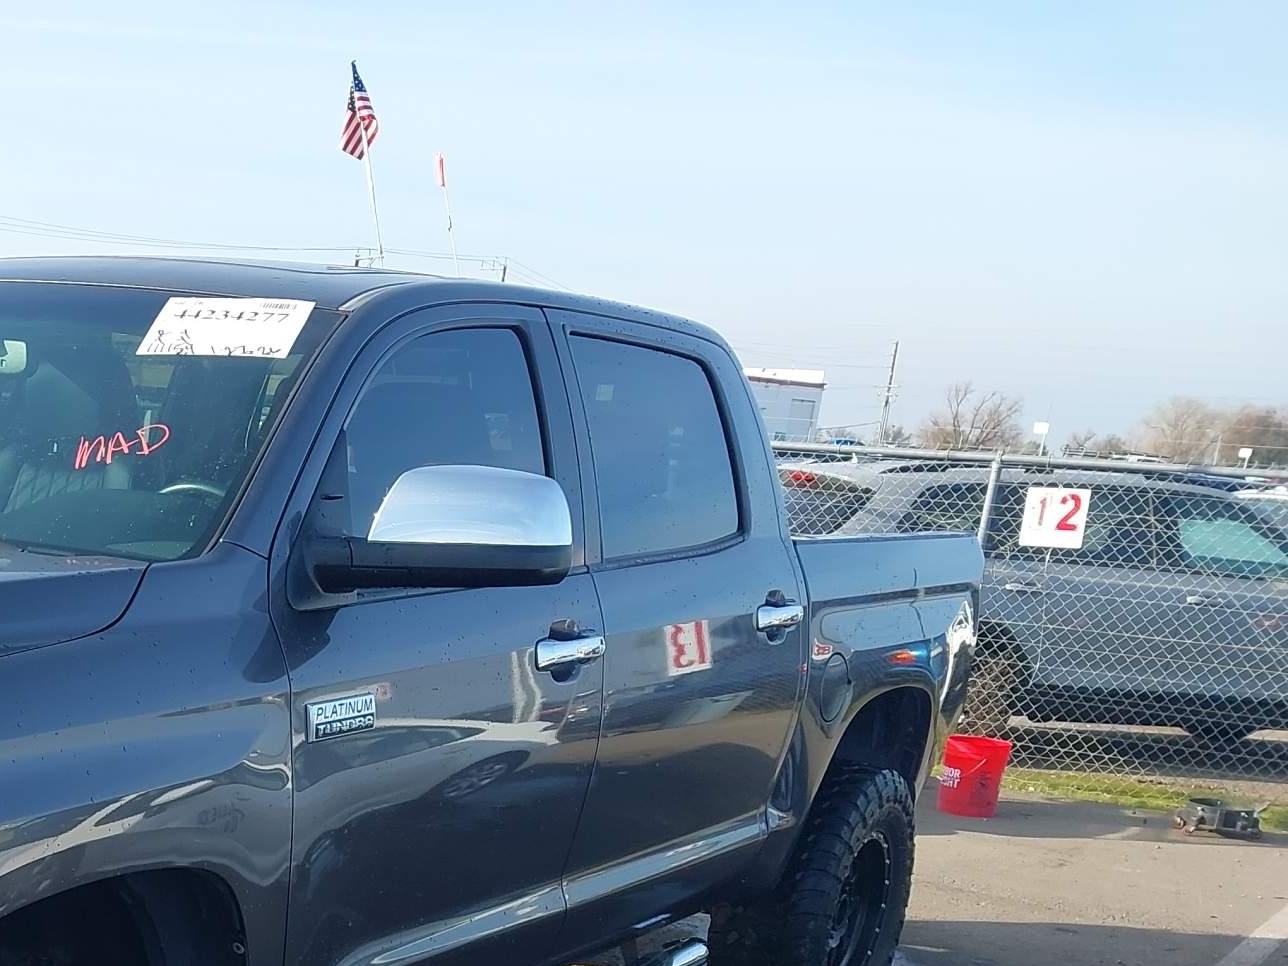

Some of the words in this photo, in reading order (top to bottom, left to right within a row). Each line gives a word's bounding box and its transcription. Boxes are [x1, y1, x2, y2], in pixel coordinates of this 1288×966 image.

[174, 308, 290, 324] 44234277
[74, 423, 171, 470] MAD
[1037, 493, 1082, 531] 12
[315, 697, 374, 721] PLATINUM
[316, 715, 374, 738] TUNDRA
